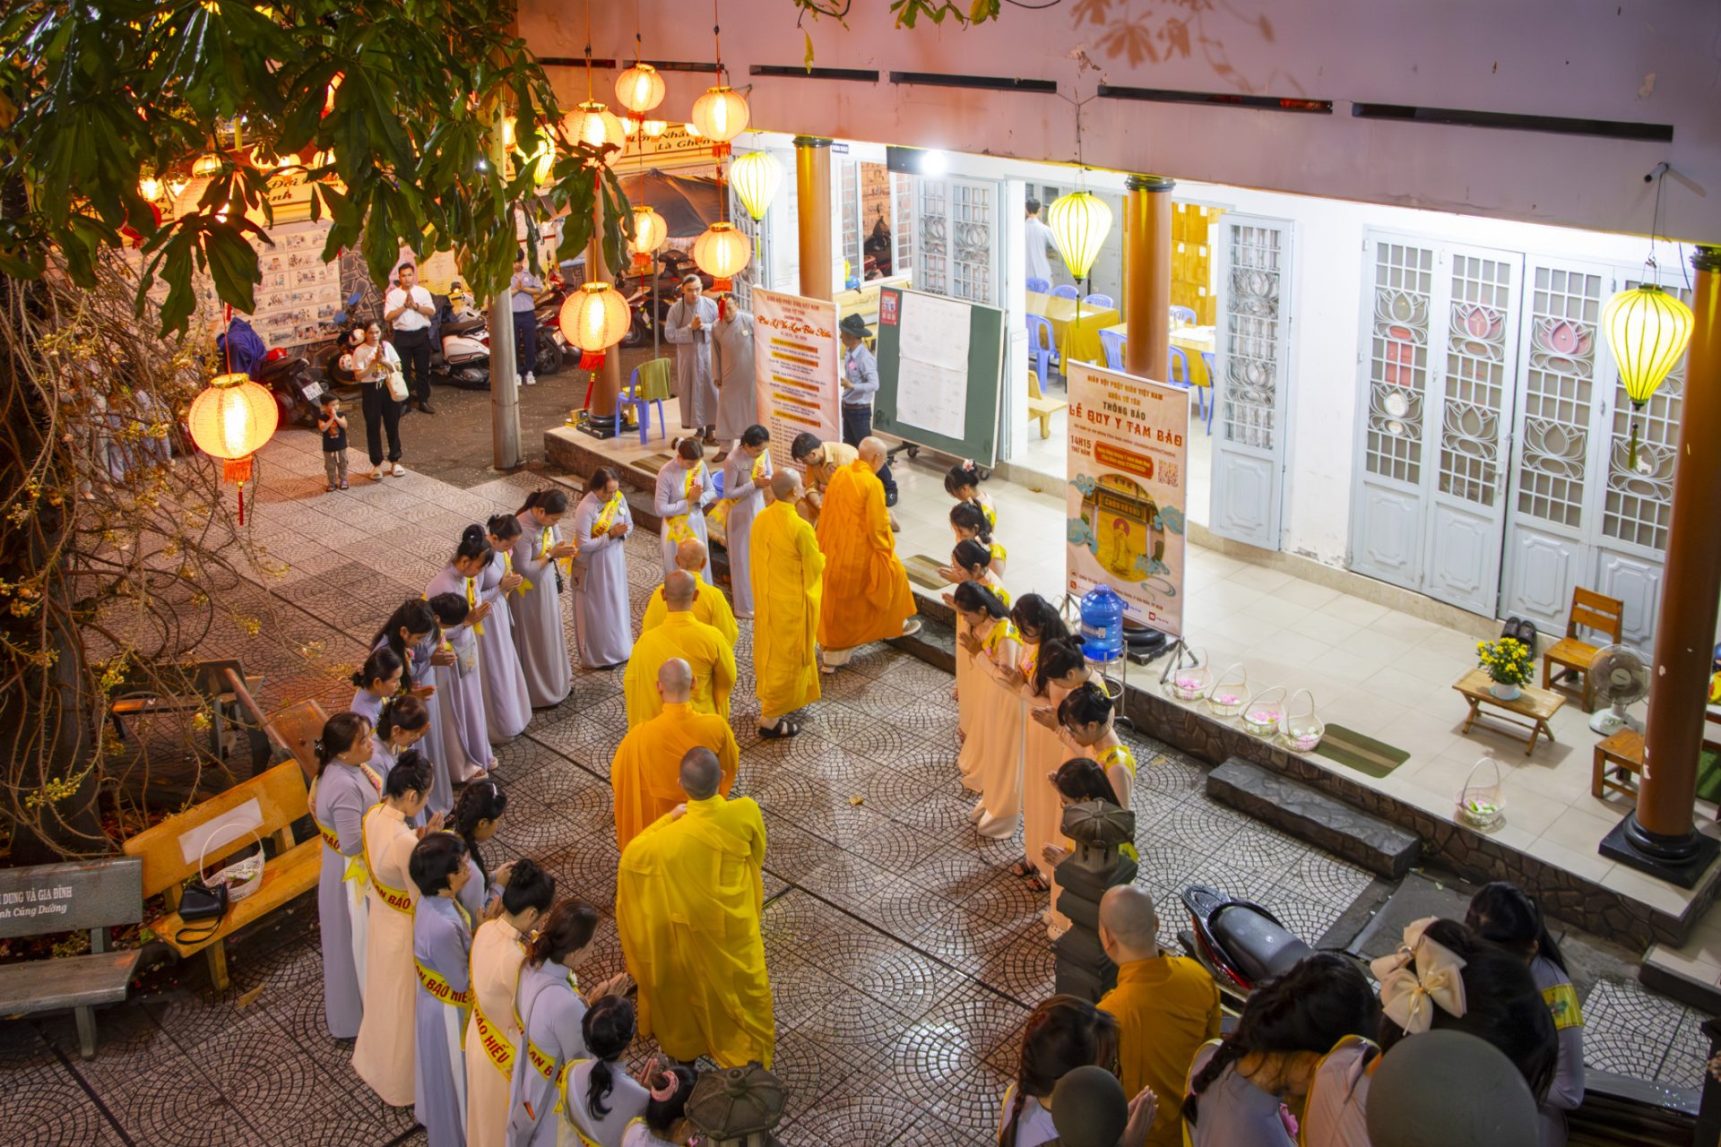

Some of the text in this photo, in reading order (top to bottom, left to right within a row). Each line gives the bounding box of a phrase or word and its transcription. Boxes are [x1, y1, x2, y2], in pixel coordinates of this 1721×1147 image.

[1103, 401, 1146, 420] THÔNG BÁO
[1087, 409, 1110, 426] QUY
[1115, 417, 1122, 429] Y
[1126, 421, 1151, 439] TAM
[1157, 428, 1183, 447] BẢO
[1071, 435, 1091, 449] 14H15
[25, 887, 37, 902] VÀ
[38, 889, 52, 901] GIA
[388, 894, 411, 910] BÁO
[427, 977, 450, 998] BÁO
[484, 1035, 510, 1064] HIẾU
